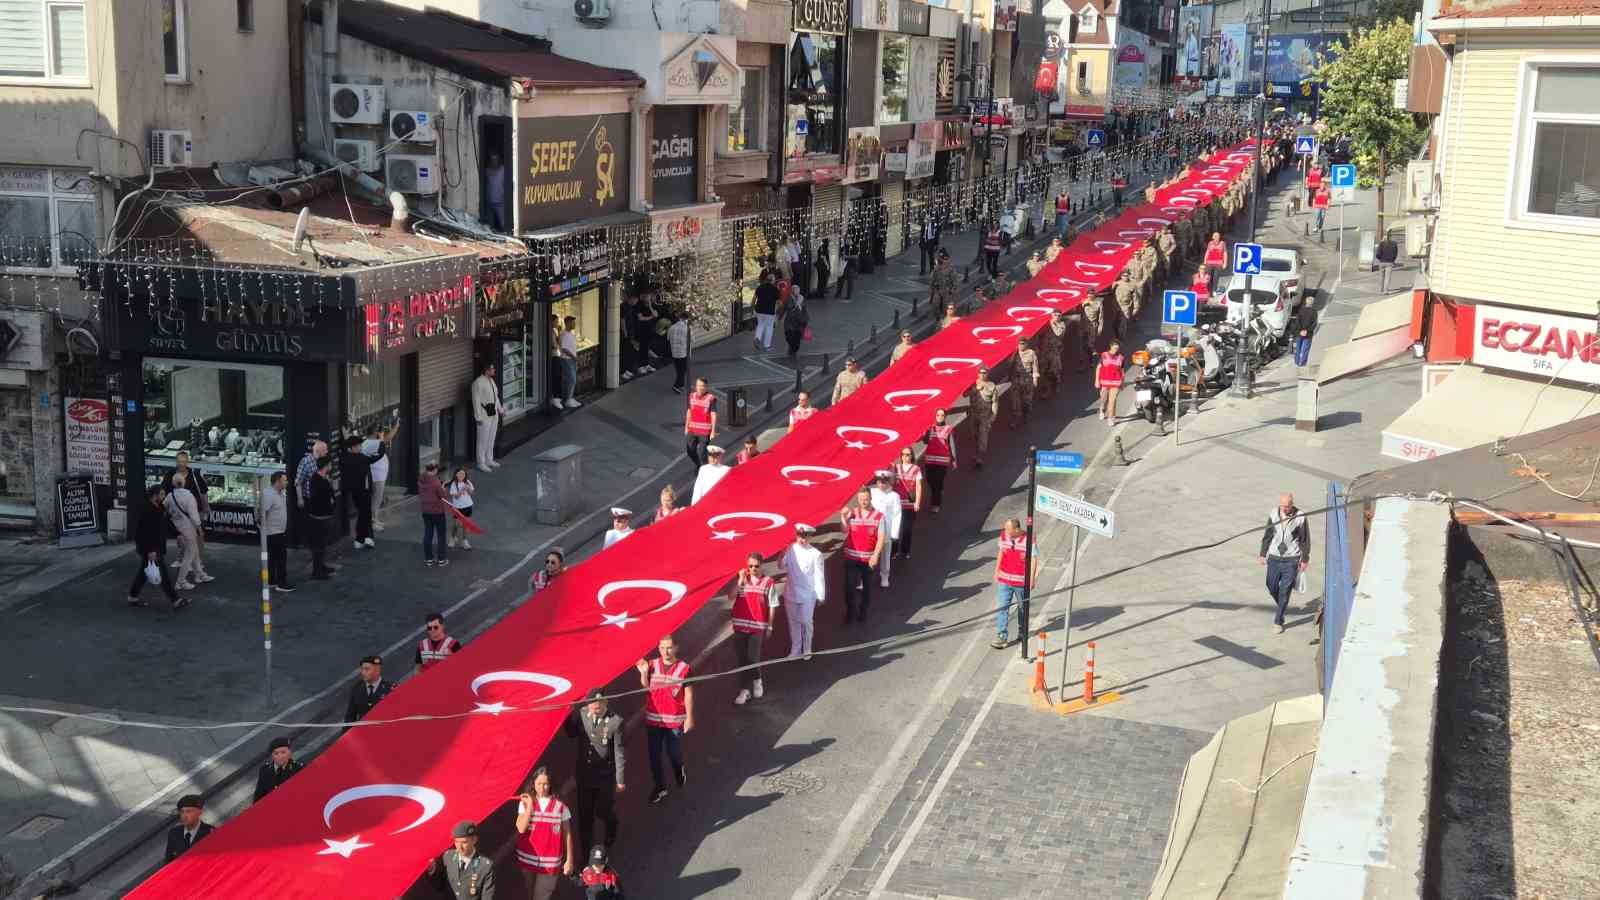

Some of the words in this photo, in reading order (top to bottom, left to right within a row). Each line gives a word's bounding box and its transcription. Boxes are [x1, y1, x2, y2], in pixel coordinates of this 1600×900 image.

[530, 140, 577, 178] ŞEREF
[1336, 166, 1349, 184] P
[524, 181, 583, 206] KUYUMCULUK
[1236, 248, 1253, 270] P
[1170, 294, 1190, 321] P
[215, 328, 303, 358] GÜMÜŞ
[208, 511, 256, 527] KAMPANYA
